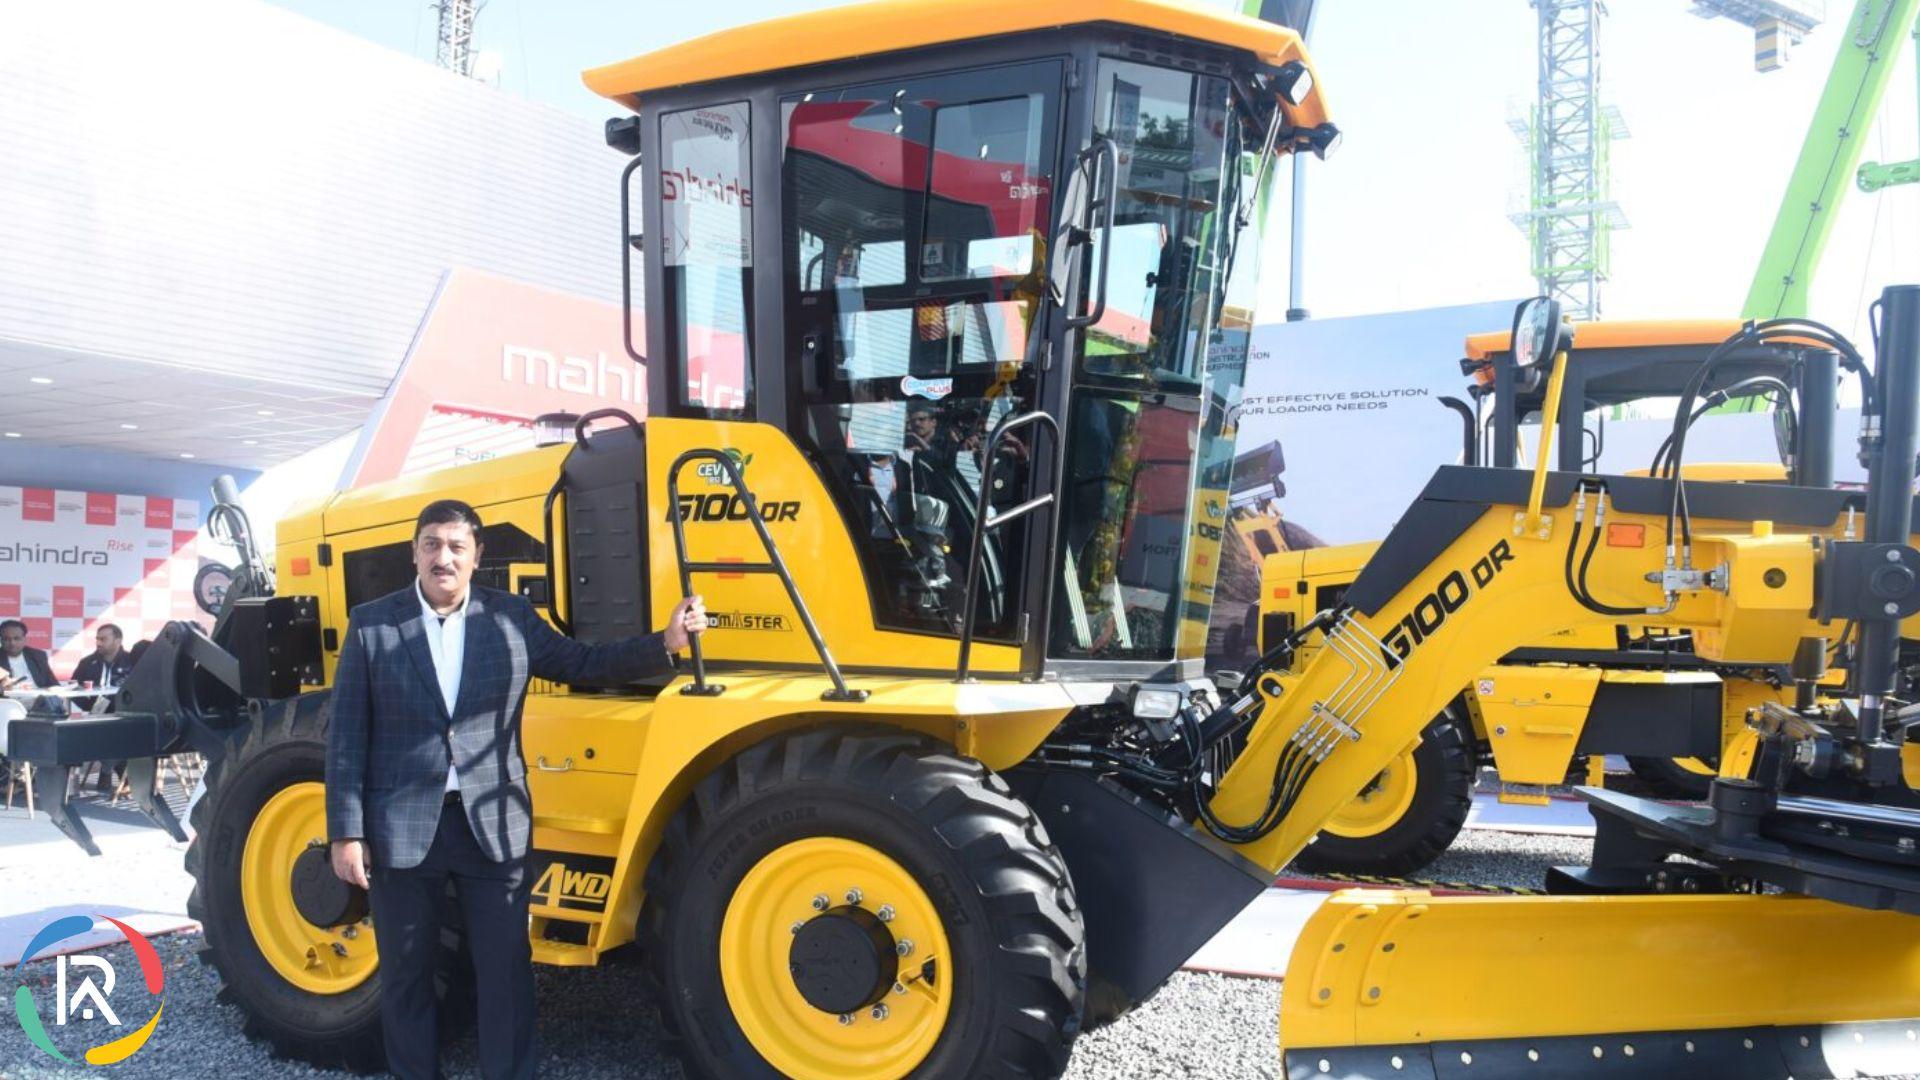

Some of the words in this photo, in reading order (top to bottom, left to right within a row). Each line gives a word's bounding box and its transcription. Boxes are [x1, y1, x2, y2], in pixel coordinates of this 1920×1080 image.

[1266, 392, 1346, 404] EFFECTIVE
[1350, 388, 1429, 399] SOLUTION
[1267, 404, 1333, 414] LOADING
[1336, 401, 1388, 411] NEEDS
[697, 463, 723, 477] CEV
[761, 501, 801, 523] DR
[0, 542, 109, 566] ahindra
[106, 539, 135, 552] Rise
[1379, 569, 1470, 672] G100
[1470, 538, 1516, 590] DR
[704, 610, 783, 630] DMASTER
[530, 862, 612, 907] 4WD
